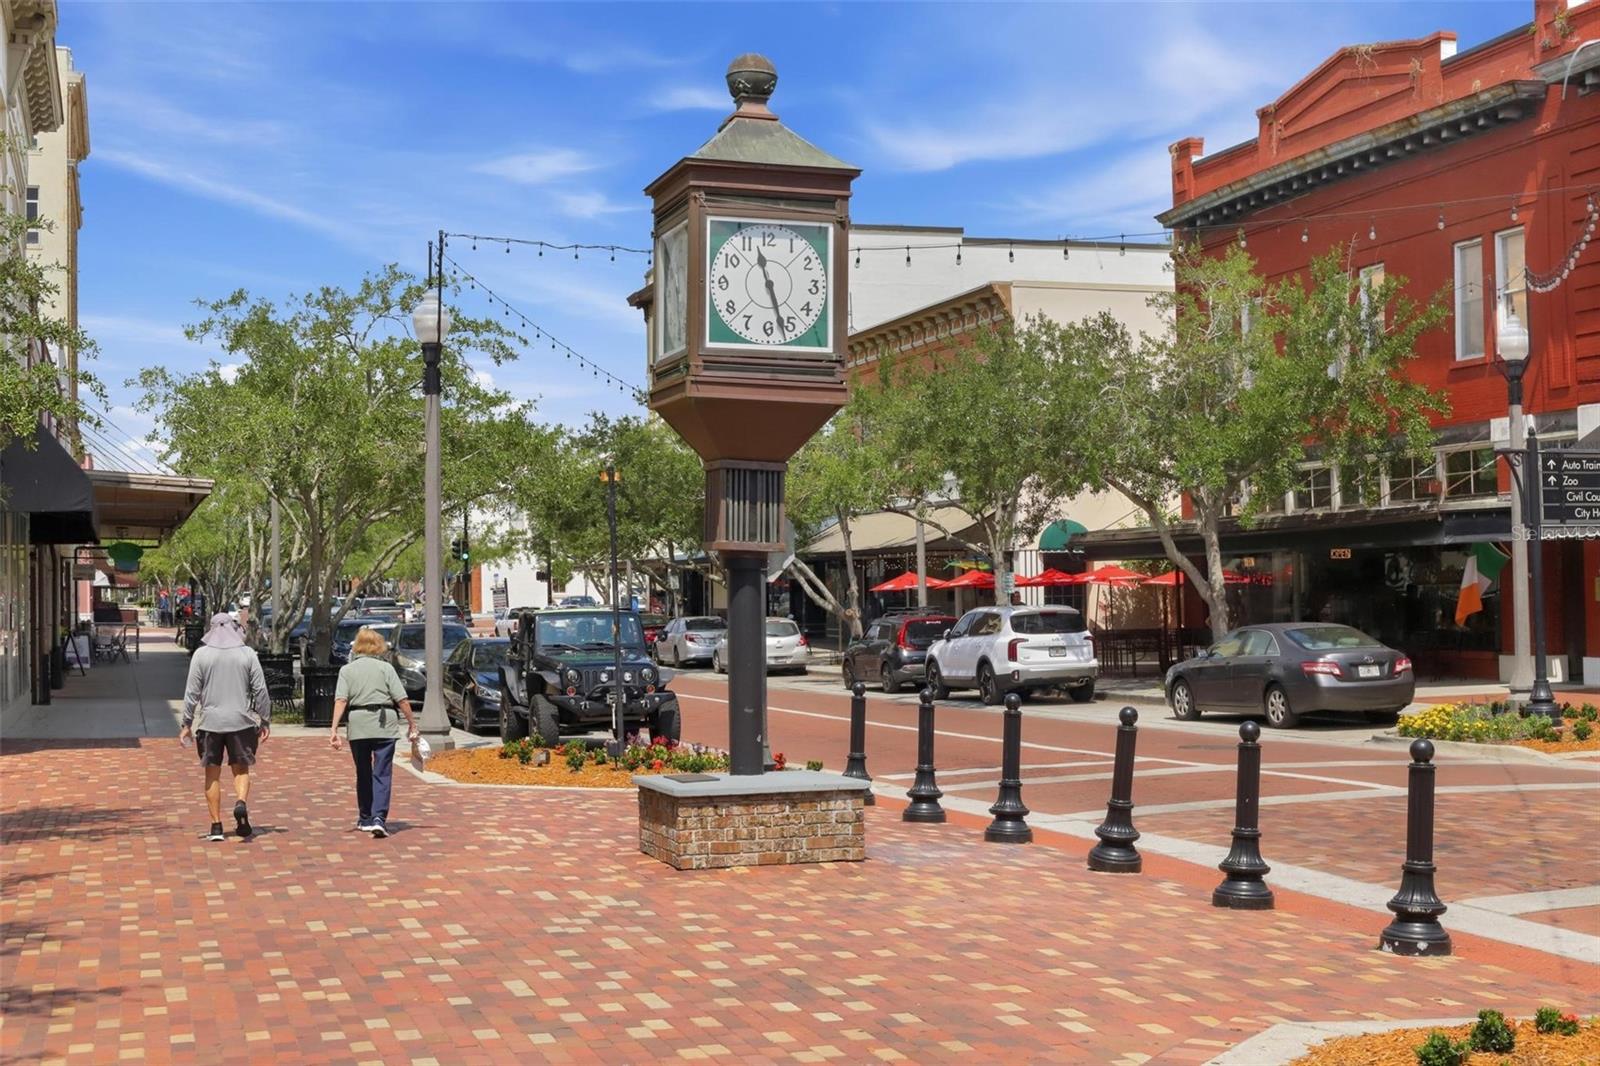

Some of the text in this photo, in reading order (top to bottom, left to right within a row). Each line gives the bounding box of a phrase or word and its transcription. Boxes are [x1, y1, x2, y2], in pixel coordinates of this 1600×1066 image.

[742, 236, 752, 251] 11
[762, 231, 776, 247] 12
[790, 238, 794, 253] 1
[725, 253, 740, 268] 10
[803, 255, 813, 271] 2
[718, 275, 729, 291] 9
[808, 279, 819, 295] 3
[725, 299, 736, 315] 8
[800, 301, 812, 317] 4
[742, 314, 753, 331] 7
[763, 320, 774, 337] 6
[785, 316, 797, 333] 5
[1562, 460, 1581, 470] Auto
[1562, 475, 1579, 486] Zoo
[1566, 491, 1584, 501] Civil
[1574, 507, 1591, 520] City
